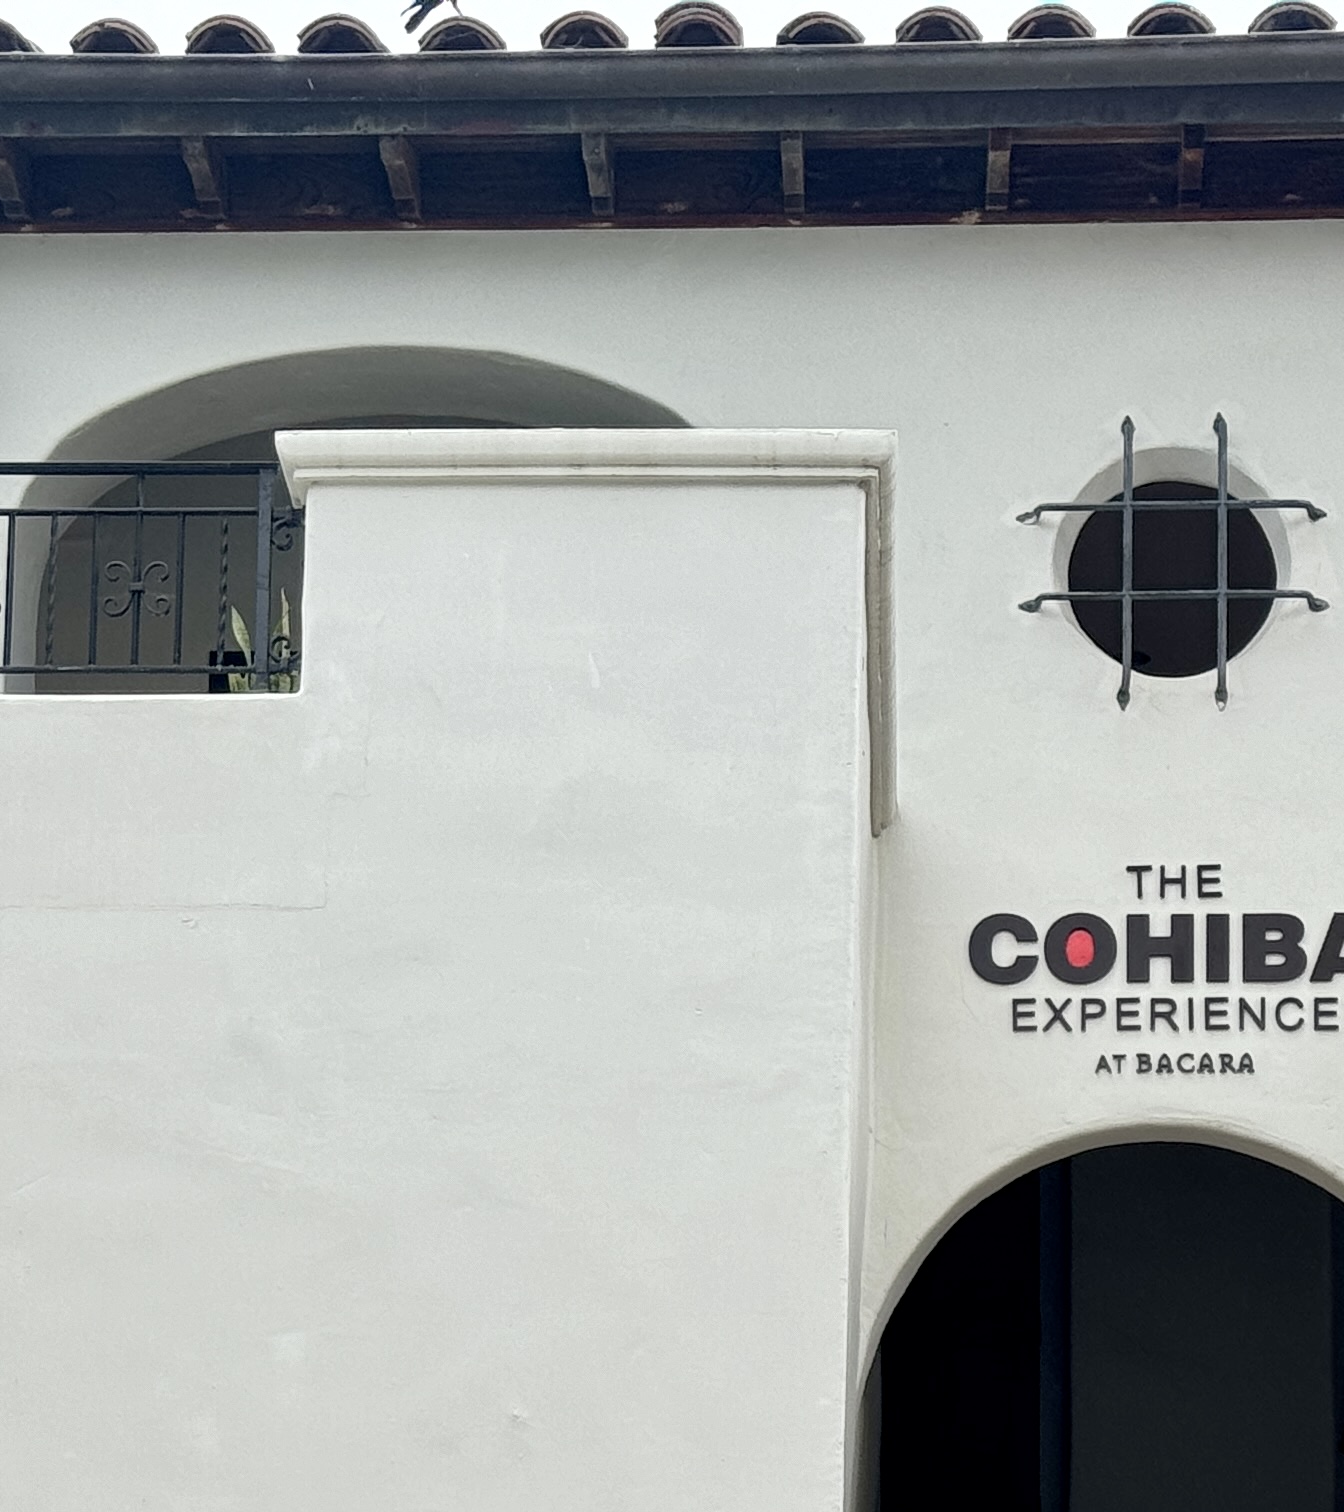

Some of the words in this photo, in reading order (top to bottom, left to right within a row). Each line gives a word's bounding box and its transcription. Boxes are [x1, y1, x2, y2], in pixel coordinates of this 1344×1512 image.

[1125, 863, 1223, 900] THE
[1011, 996, 1341, 1034] EXPERIENCE
[1094, 1053, 1127, 1075] AT
[1135, 1052, 1256, 1075] BACARA
